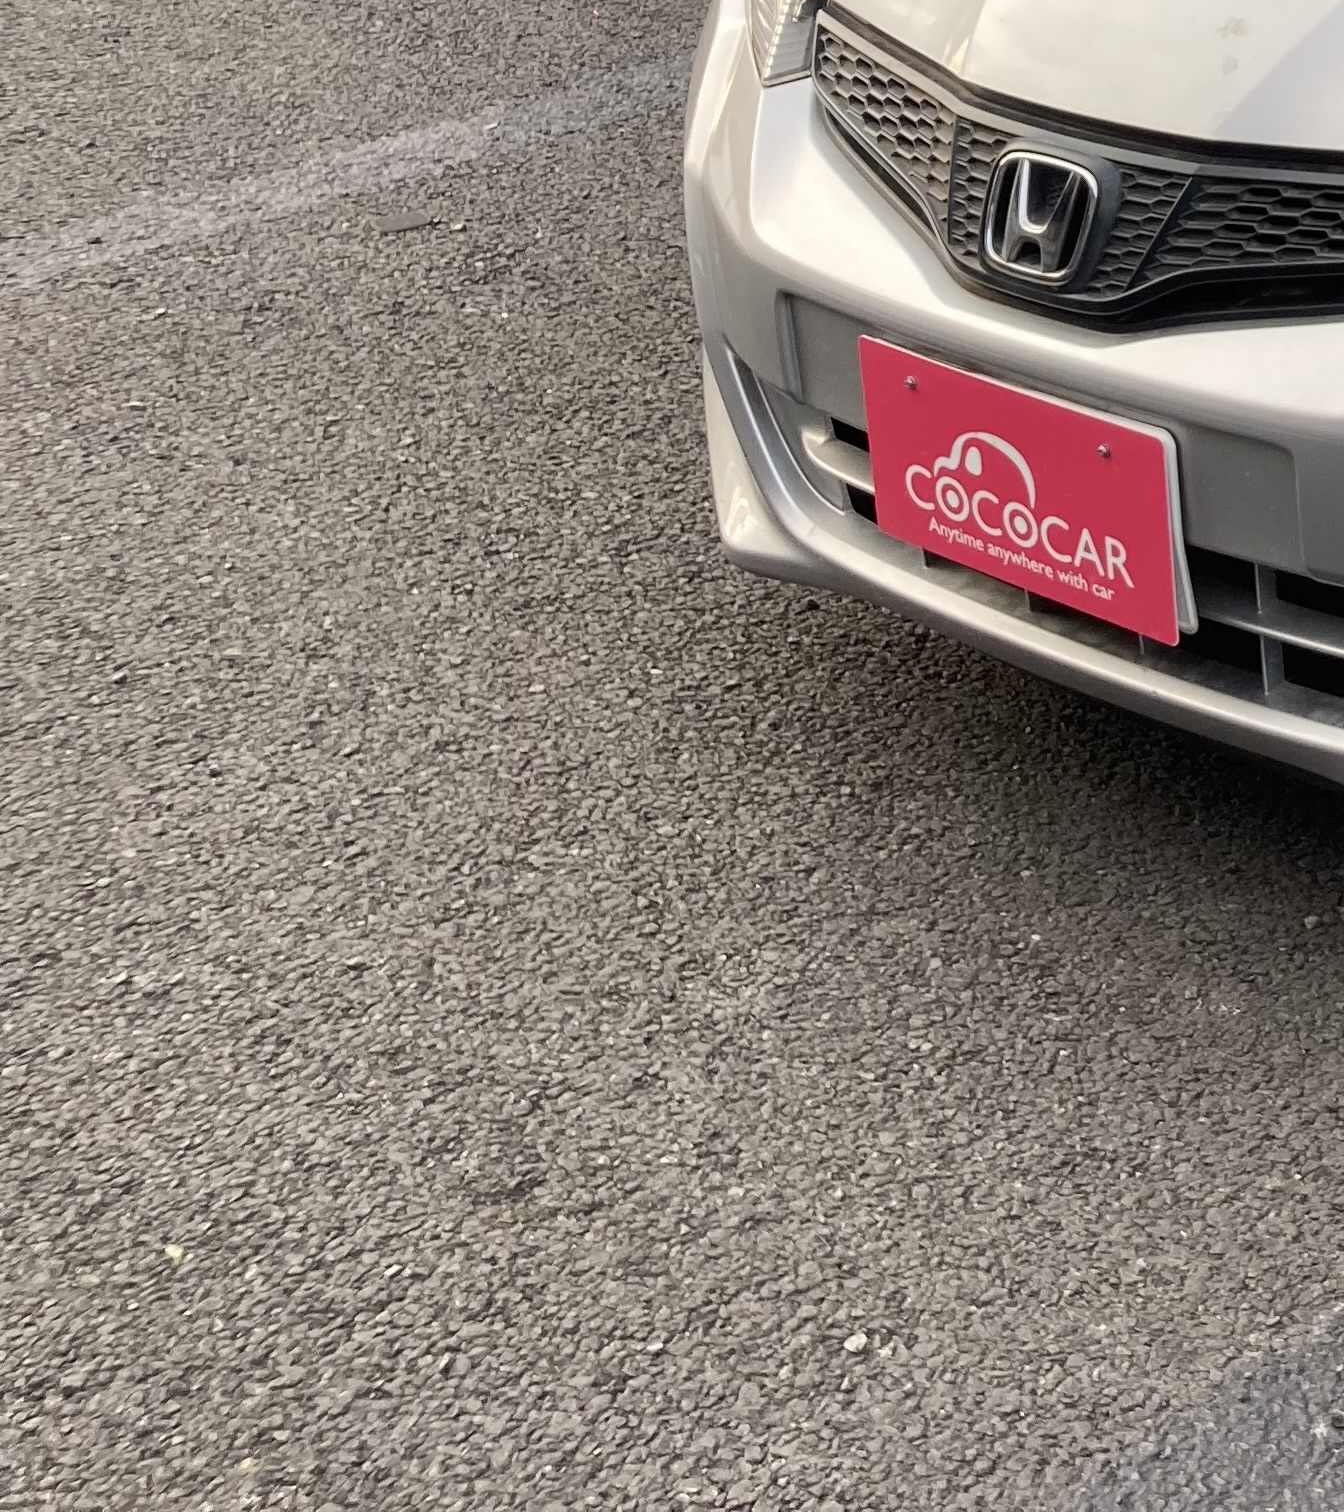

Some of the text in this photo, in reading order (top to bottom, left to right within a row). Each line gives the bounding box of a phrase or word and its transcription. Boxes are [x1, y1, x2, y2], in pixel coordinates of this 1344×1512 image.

[929, 516, 1115, 601] Anytime anywhere with car
